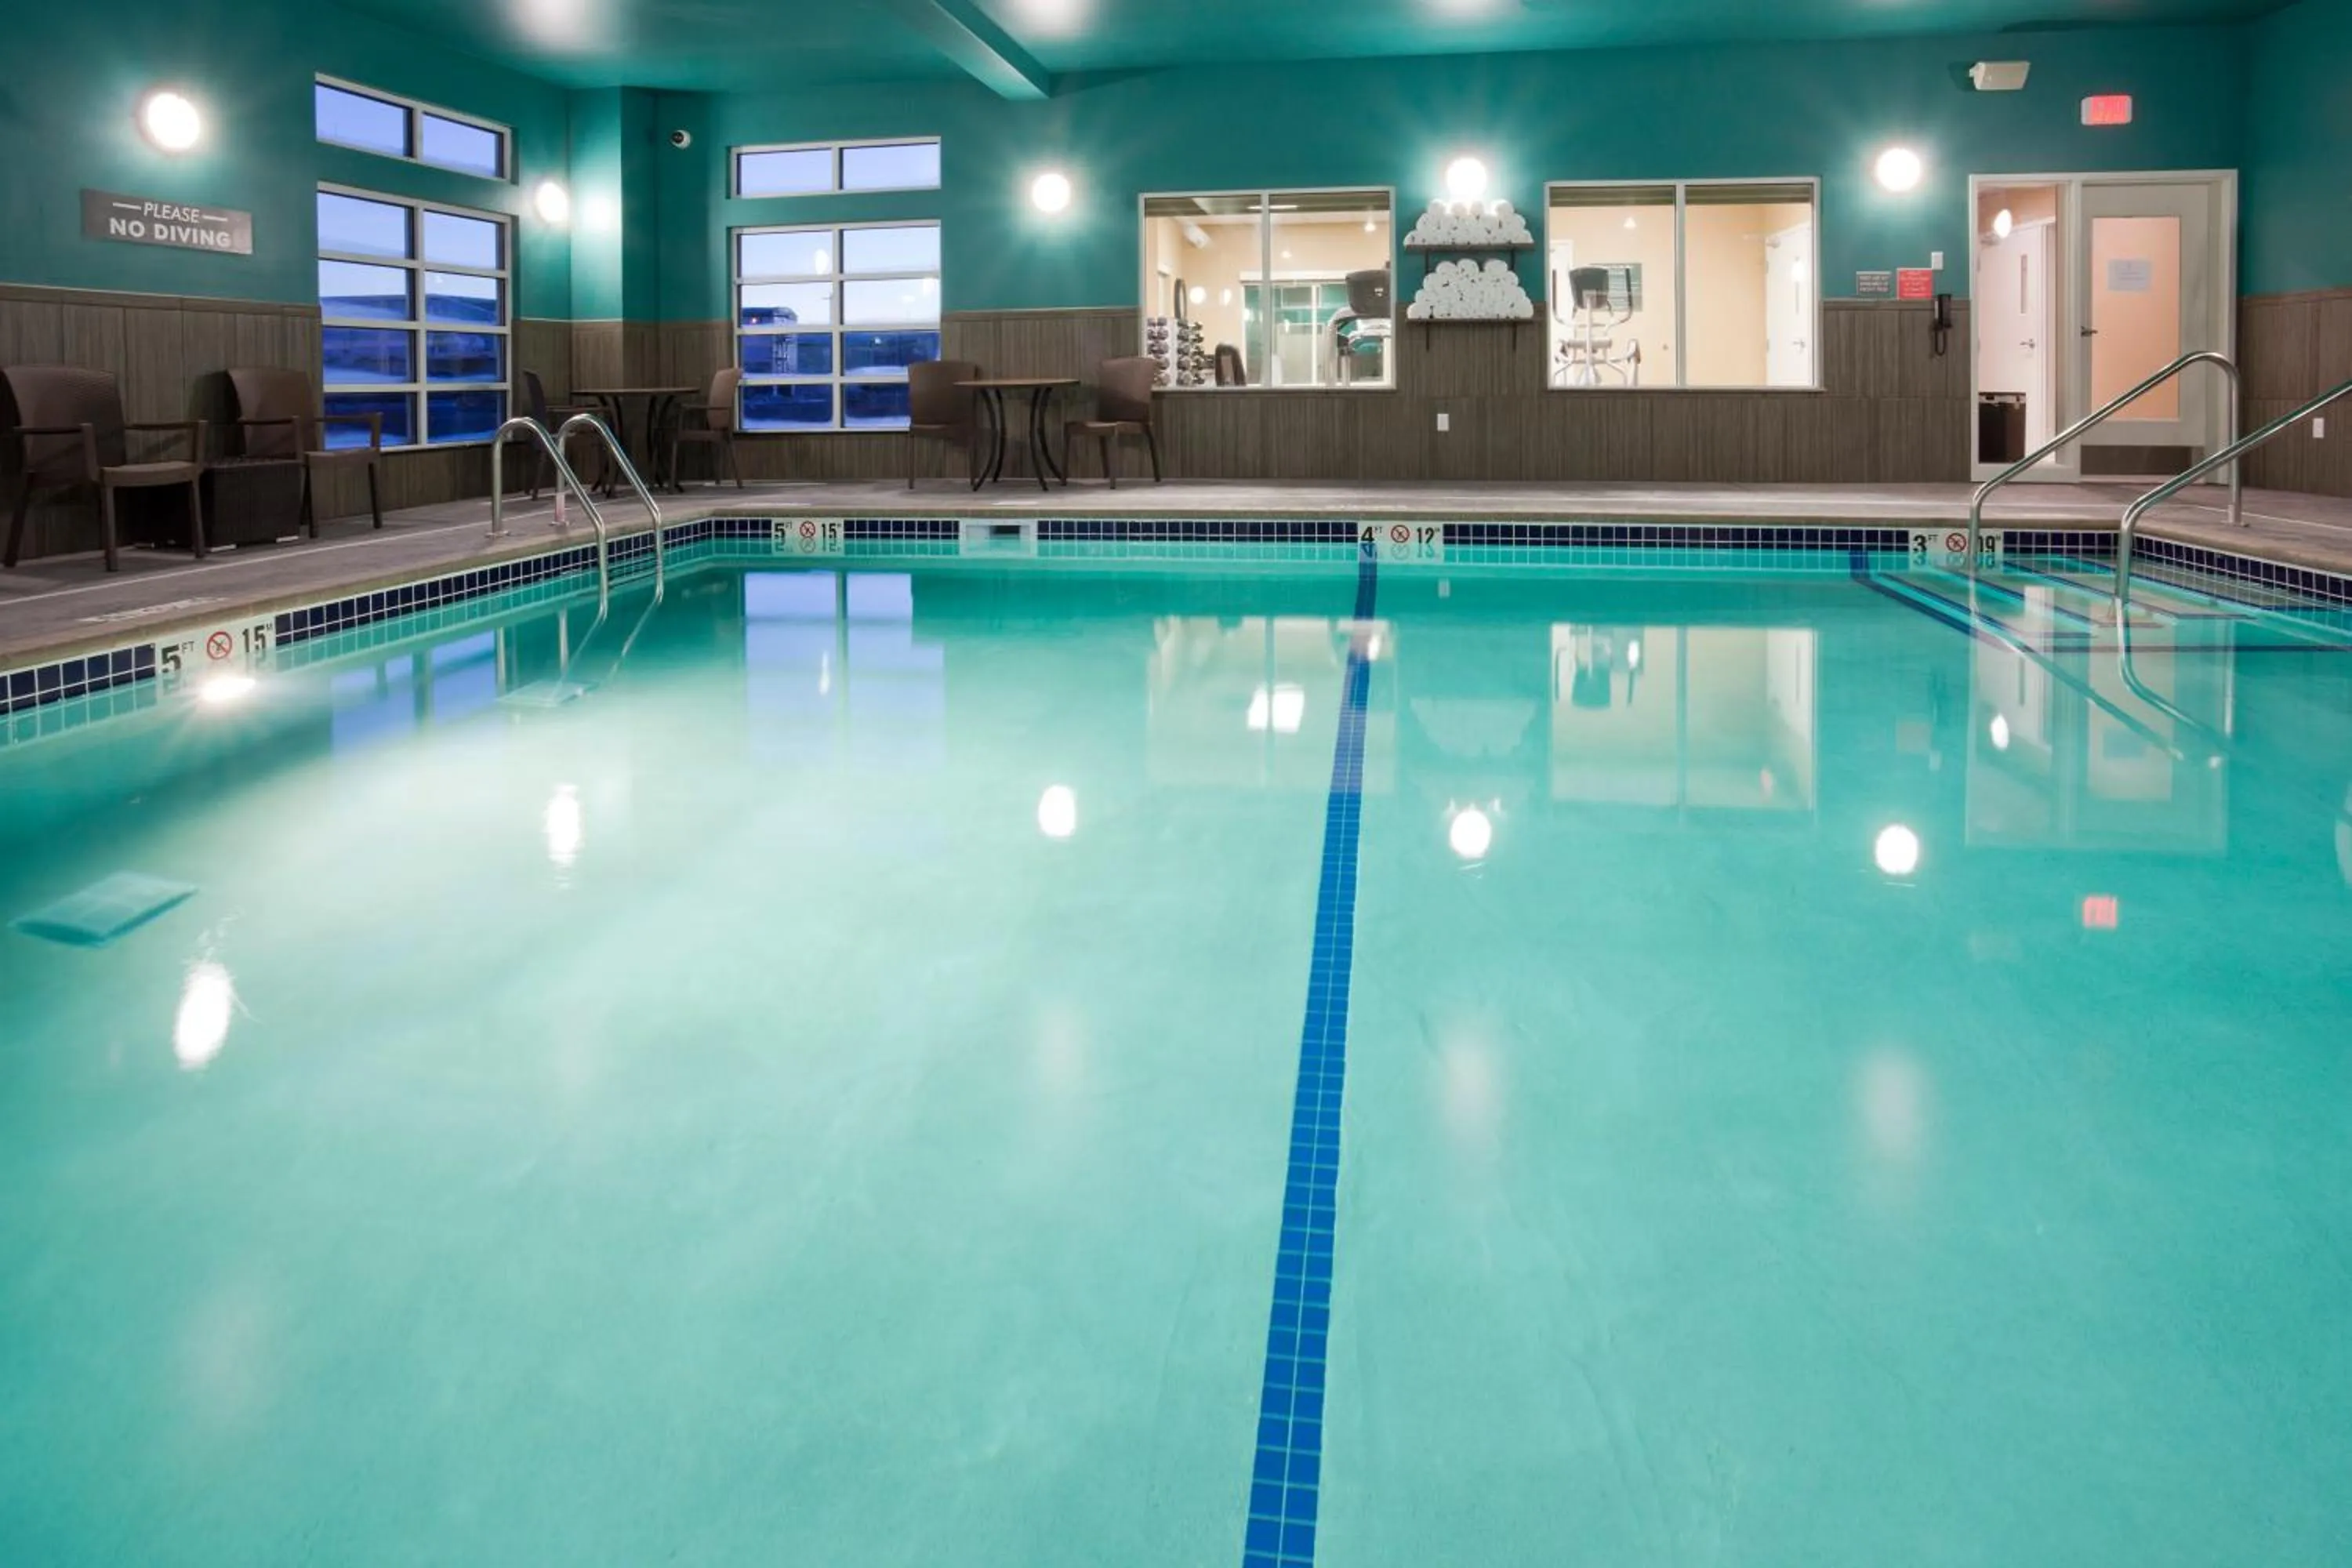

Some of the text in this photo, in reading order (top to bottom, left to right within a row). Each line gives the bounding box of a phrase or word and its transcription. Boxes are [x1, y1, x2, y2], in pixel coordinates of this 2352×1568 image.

[143, 201, 201, 223] PLEASE
[108, 217, 231, 248] NO DIVING
